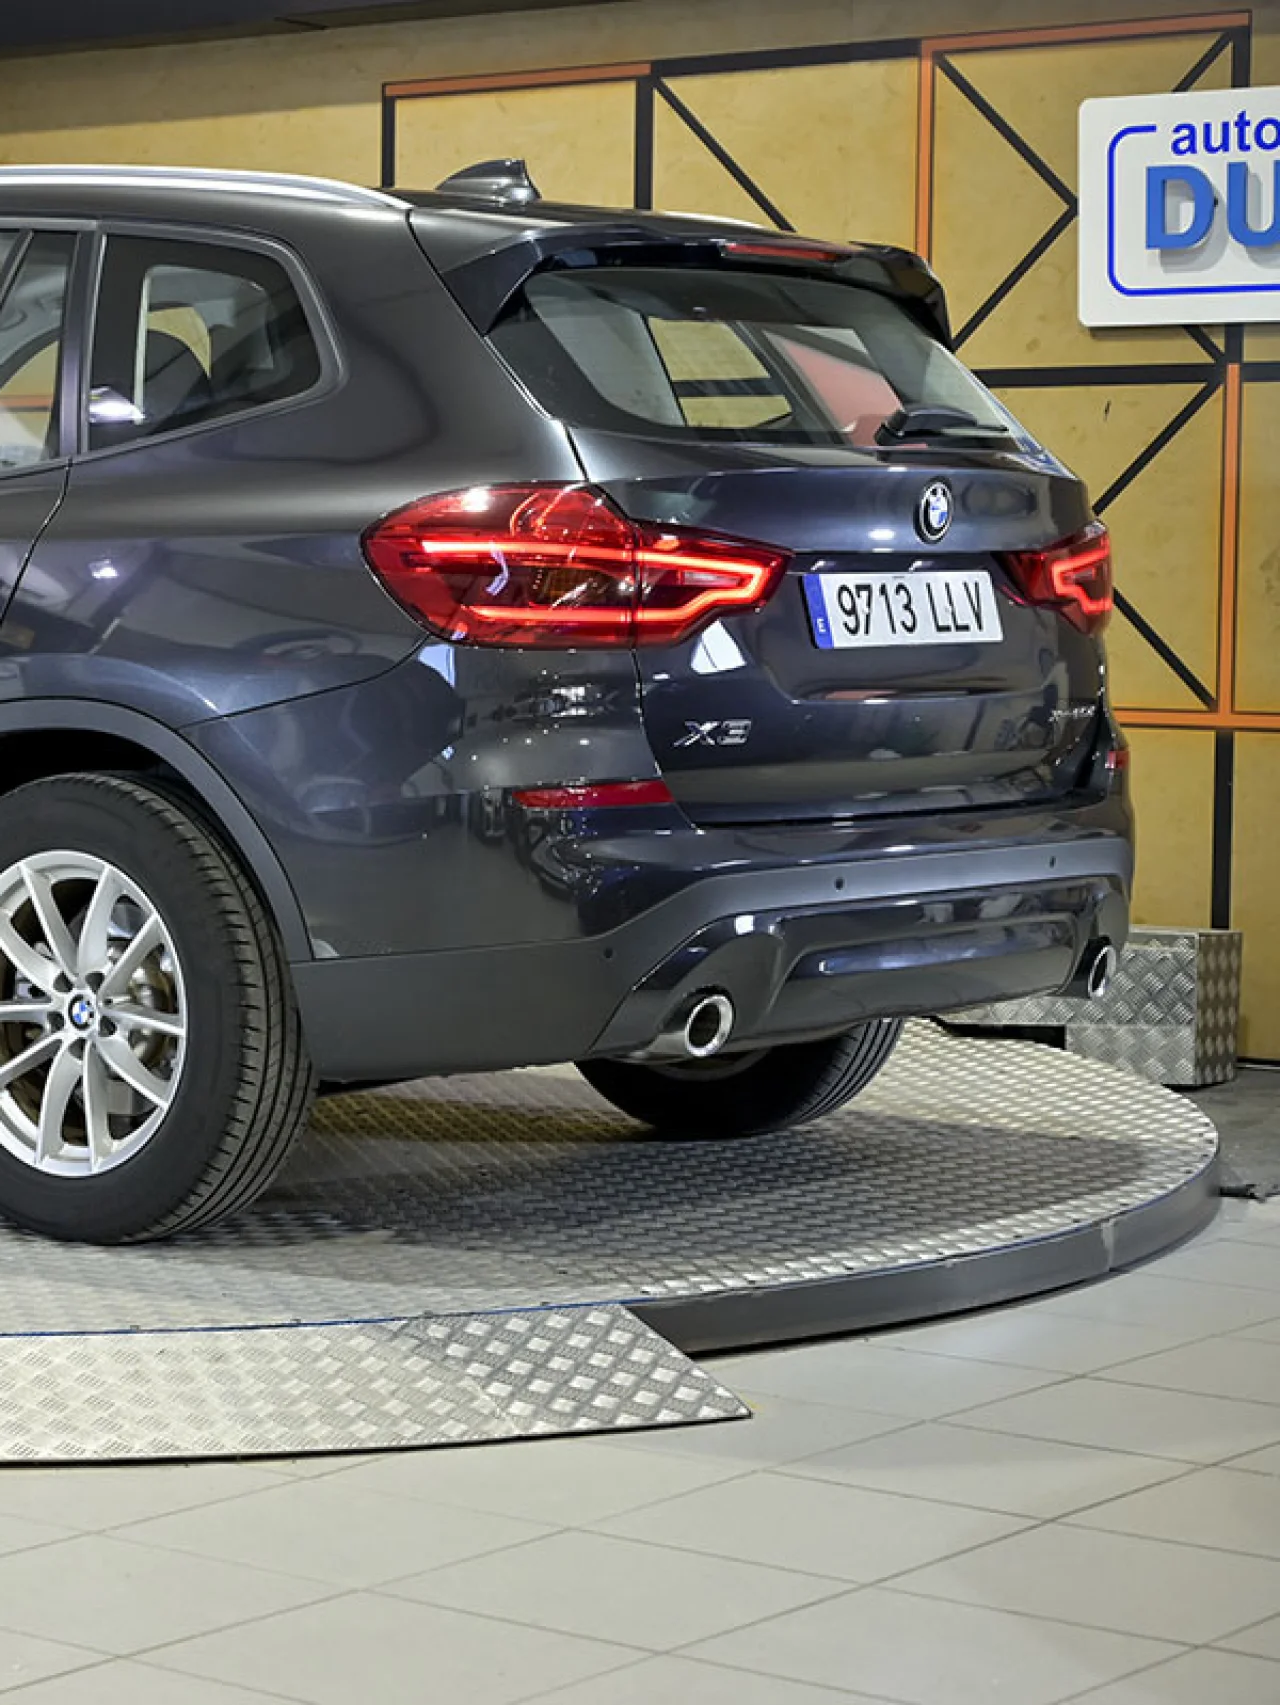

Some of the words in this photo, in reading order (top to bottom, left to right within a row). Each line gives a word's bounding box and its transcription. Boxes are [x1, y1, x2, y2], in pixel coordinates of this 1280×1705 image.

[837, 581, 917, 636] 9713
[926, 581, 984, 633] LLV
[816, 618, 827, 633] E
[673, 719, 752, 746] X3
